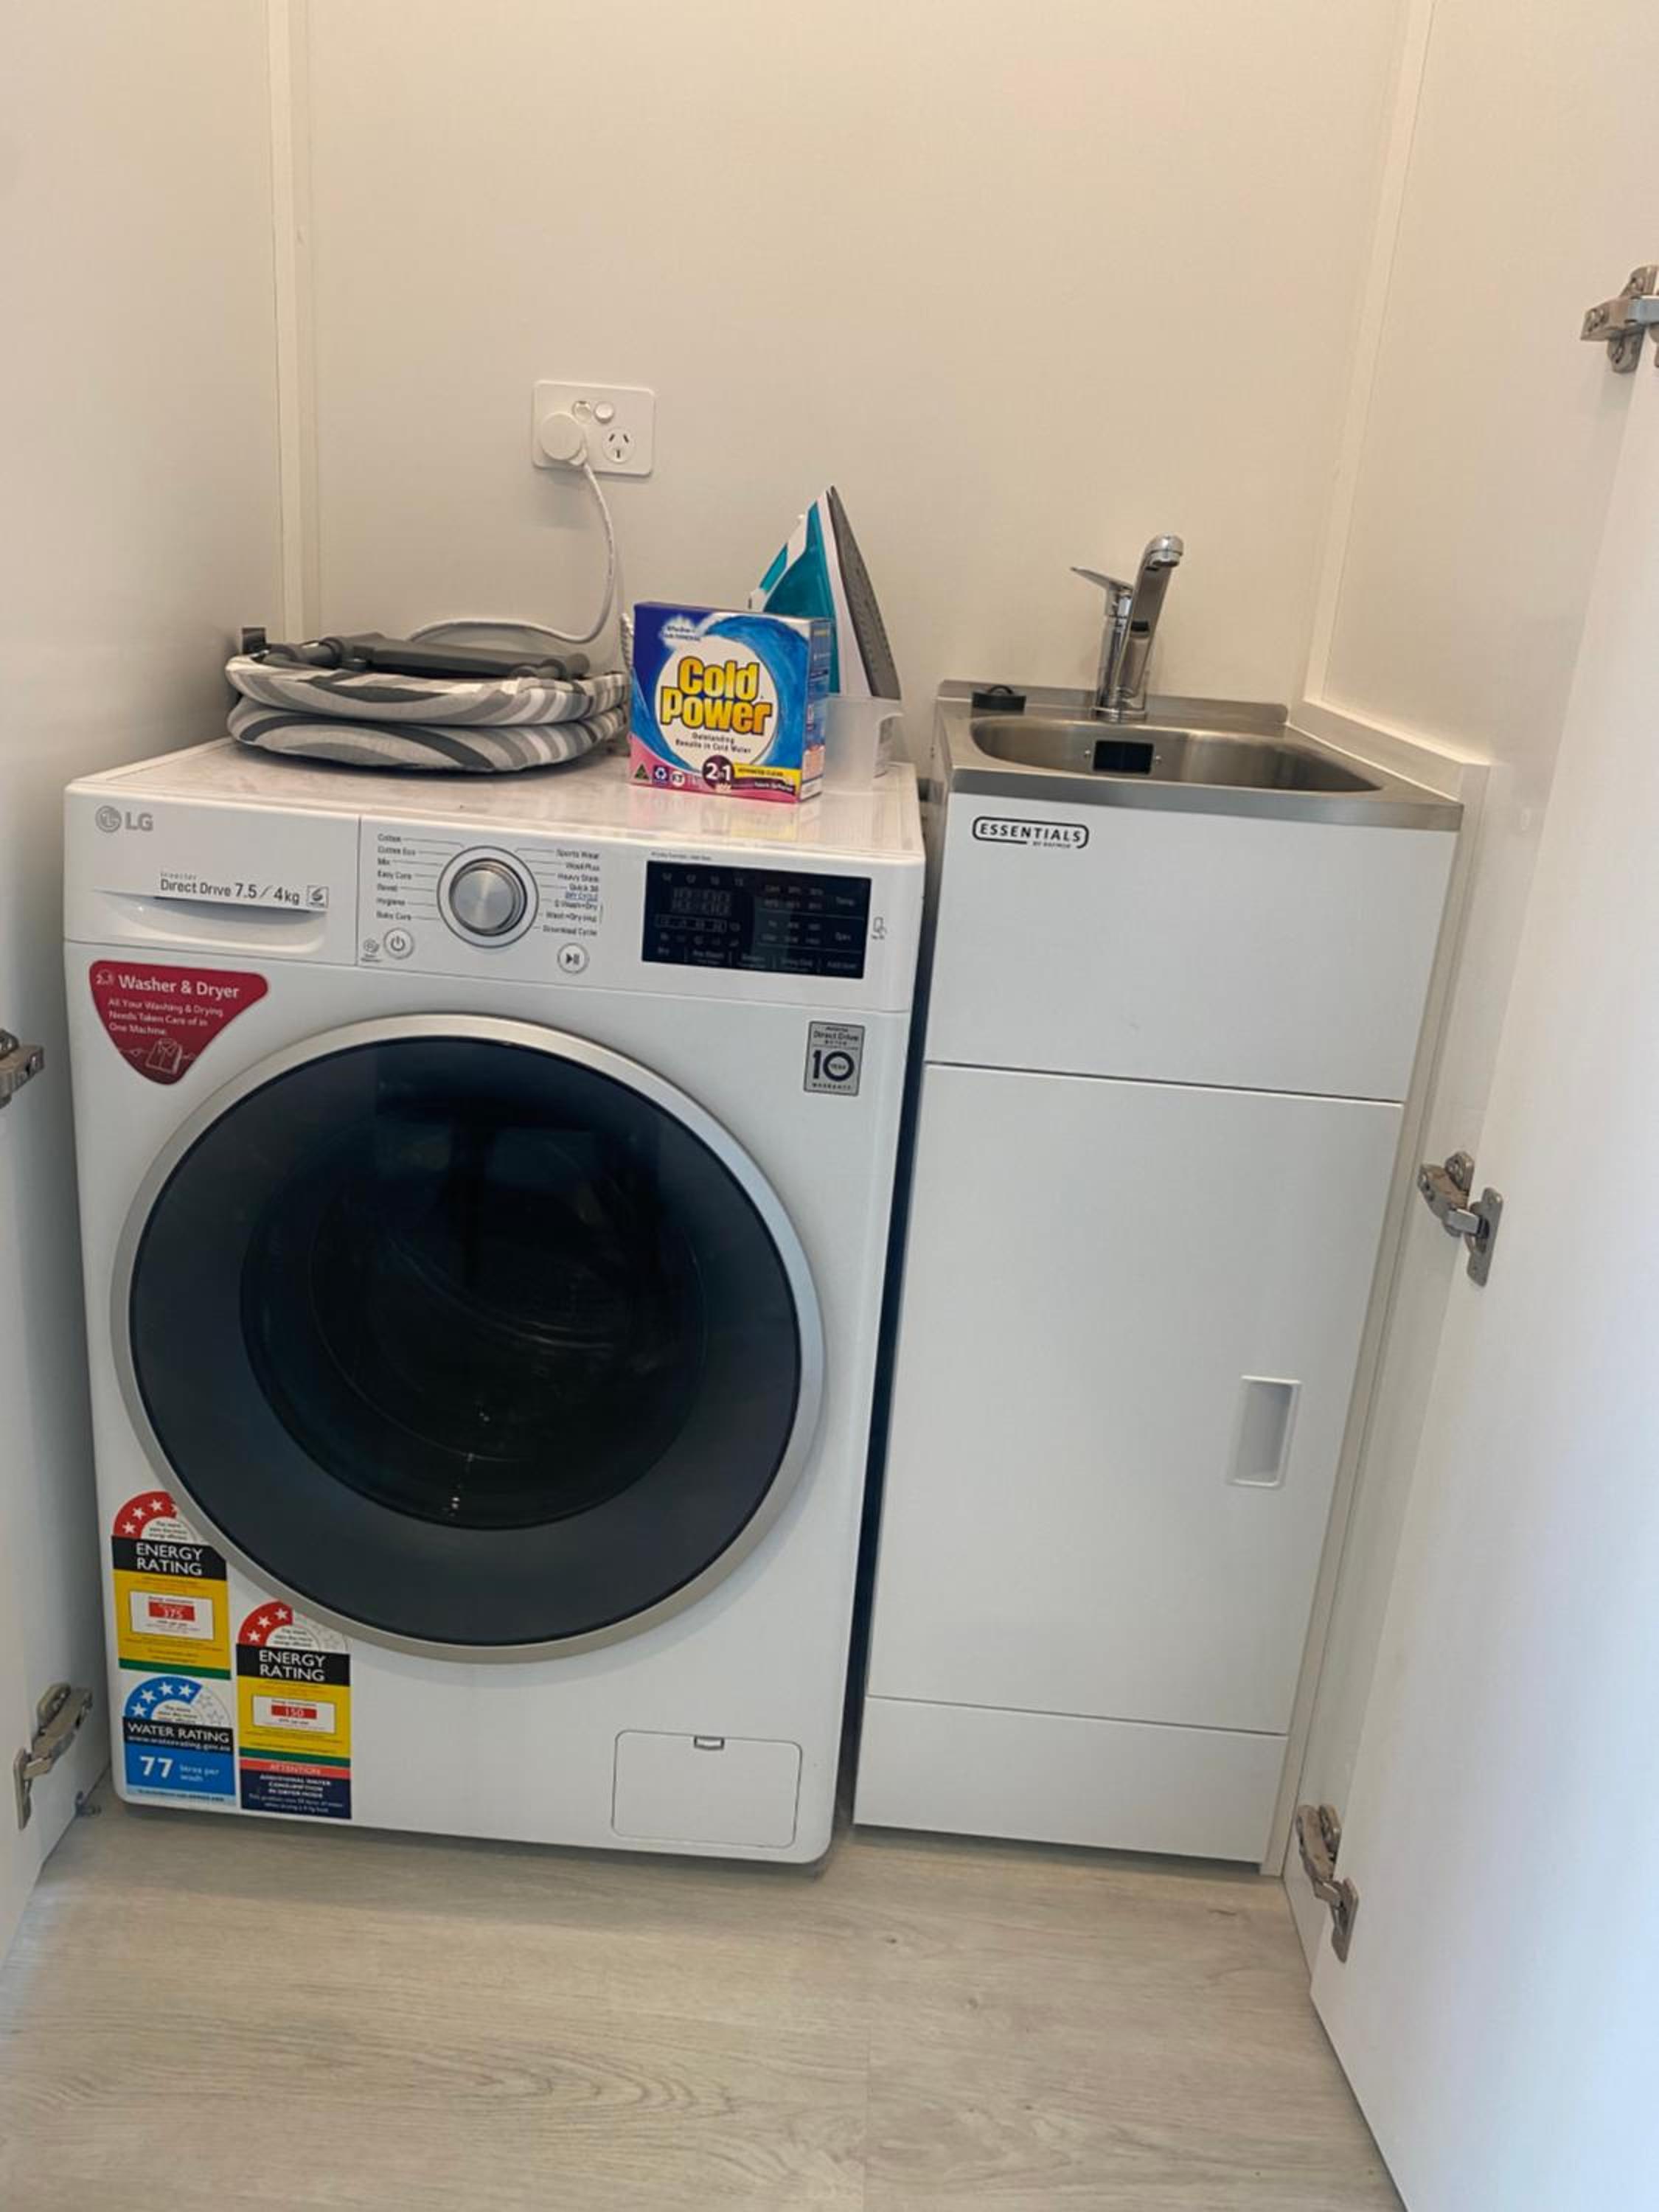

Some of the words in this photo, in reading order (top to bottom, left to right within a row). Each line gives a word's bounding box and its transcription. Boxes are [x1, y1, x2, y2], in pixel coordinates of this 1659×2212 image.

[678, 655, 760, 700] Cold
[660, 686, 773, 736] Power
[125, 812, 153, 832] LG
[979, 823, 1081, 842] ESSENTIALS
[160, 878, 196, 894] Direct
[200, 882, 232, 897] Drive
[118, 974, 177, 993] Washer
[181, 980, 192, 995] &
[196, 981, 240, 1001] Dryer
[122, 999, 142, 1009] Your
[145, 1001, 184, 1015] Washing
[193, 1005, 224, 1018] Drying
[165, 1015, 187, 1026] Care
[136, 1543, 203, 1561] ENERGY
[136, 1557, 203, 1576] RATING
[259, 1649, 326, 1667] ENERGY
[260, 1663, 326, 1682] RATING
[128, 1722, 174, 1737] WATER
[178, 1728, 229, 1744] RATING
[139, 1755, 173, 1779] 77
